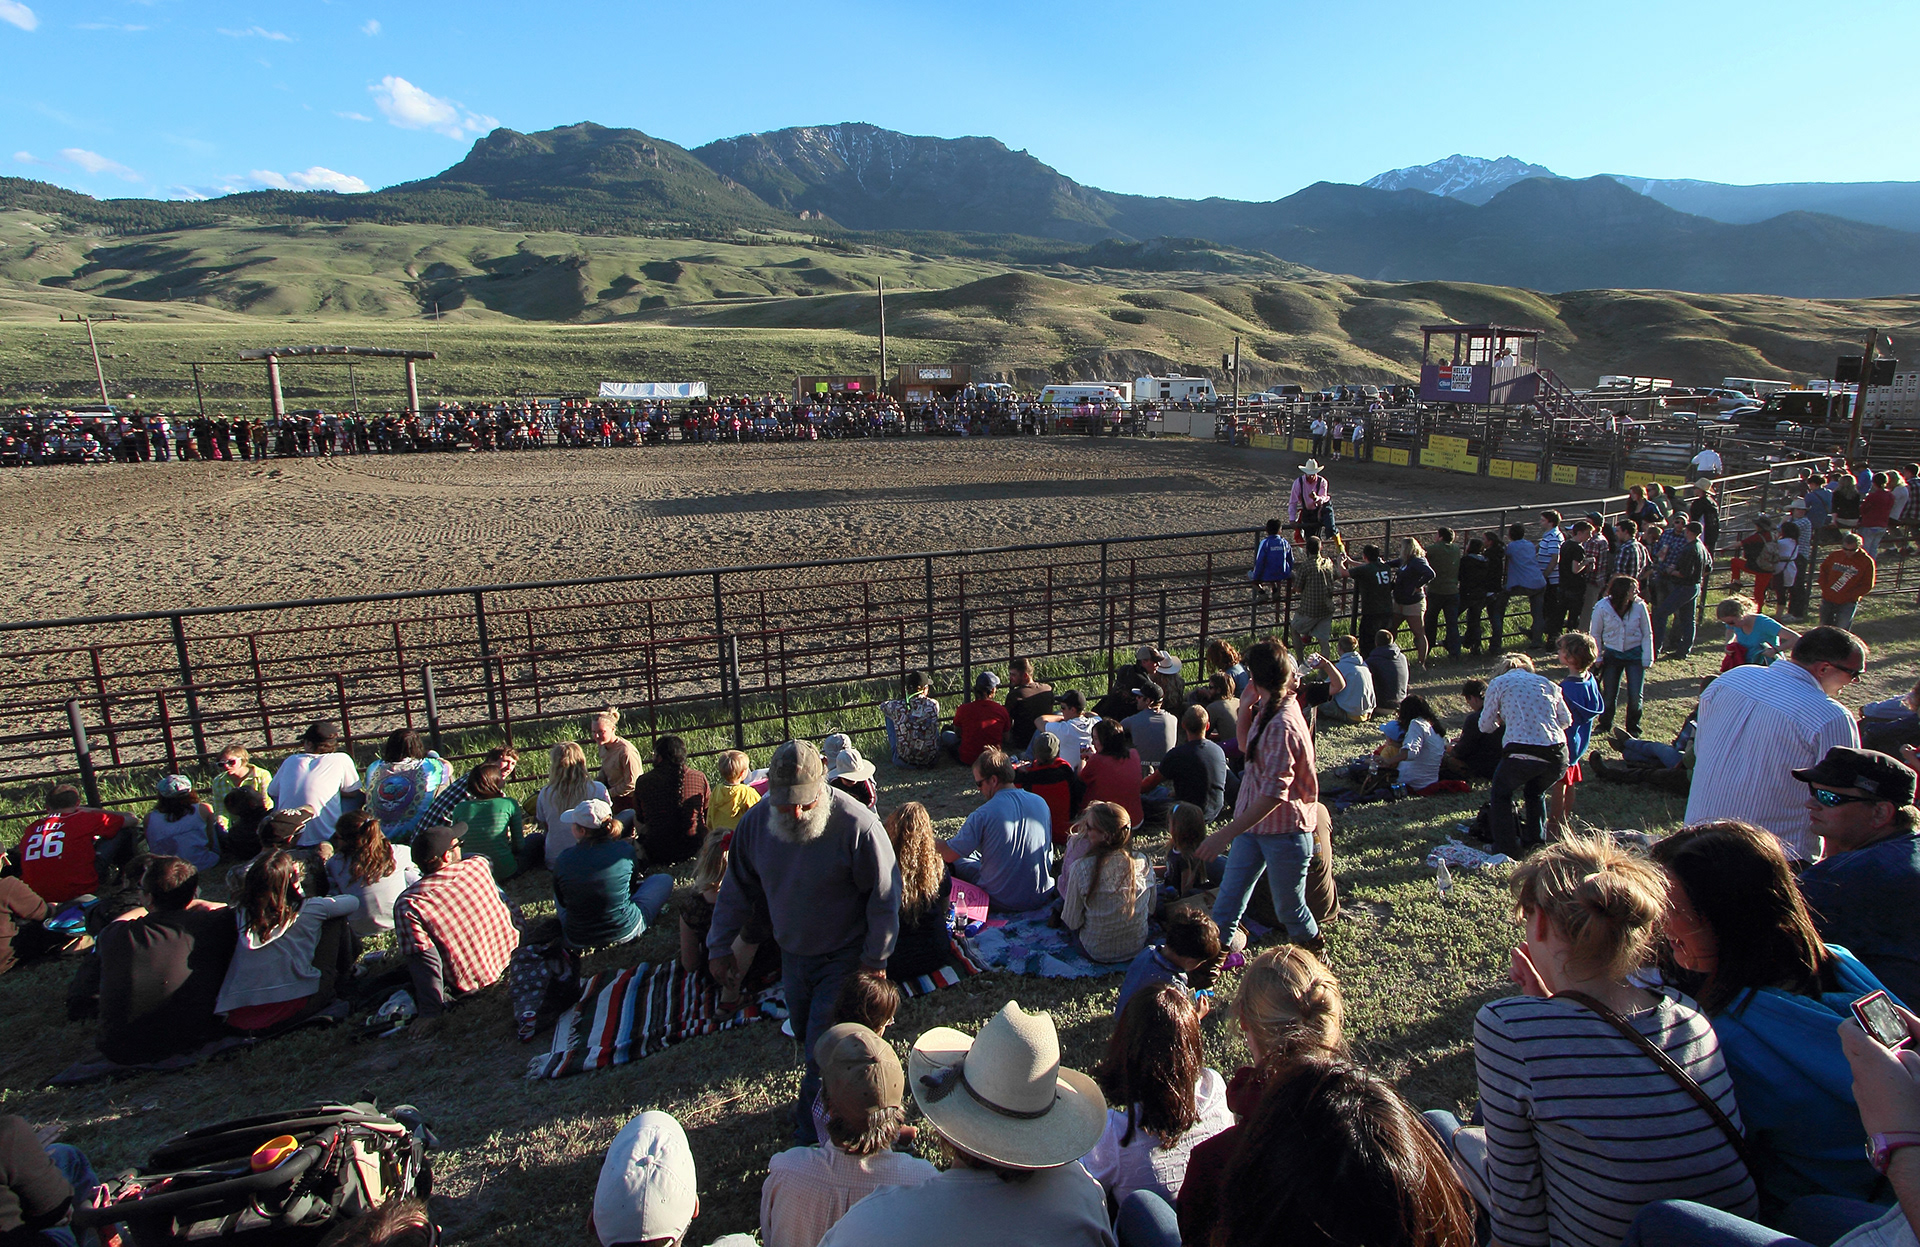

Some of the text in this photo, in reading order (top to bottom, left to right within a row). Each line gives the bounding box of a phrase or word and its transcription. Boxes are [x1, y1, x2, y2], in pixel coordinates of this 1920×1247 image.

[1375, 571, 1390, 585] 15
[36, 822, 65, 832] ULEY
[25, 831, 65, 861] 26
